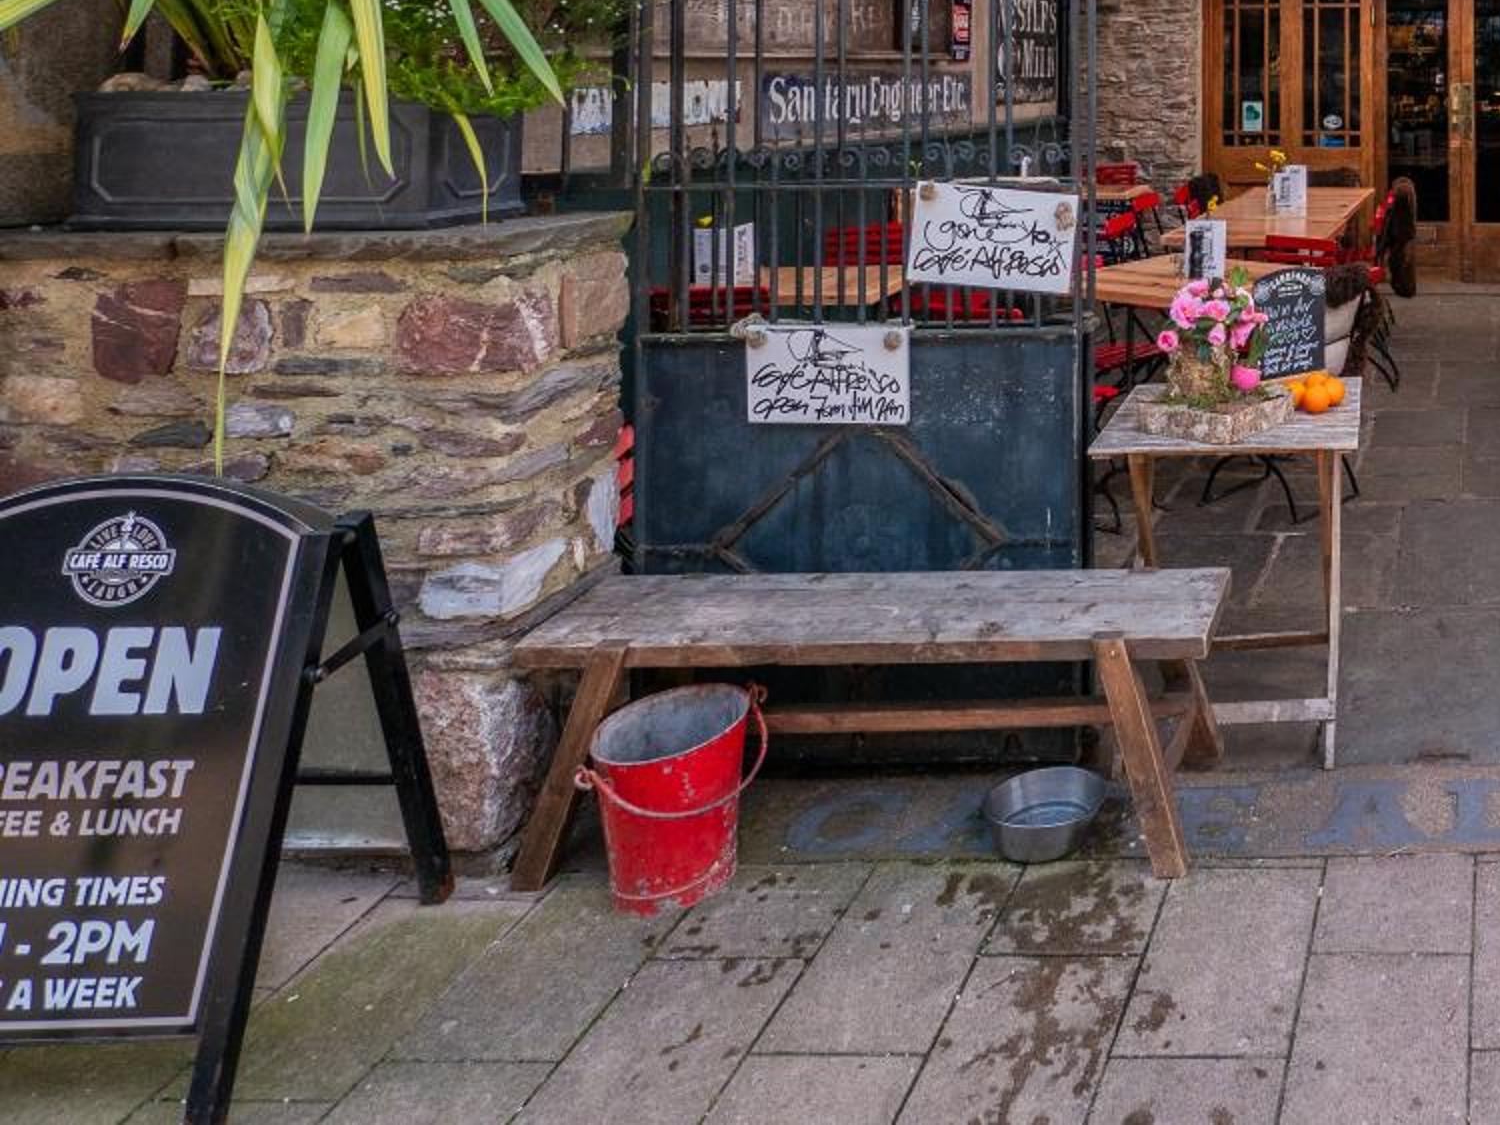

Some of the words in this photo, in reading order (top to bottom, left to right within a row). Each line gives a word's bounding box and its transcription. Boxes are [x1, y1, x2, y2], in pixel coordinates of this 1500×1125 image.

[769, 75, 867, 125] Santary
[69, 552, 102, 569] CAFÉ
[102, 554, 128, 569] ALF
[129, 554, 169, 569] RESCO
[0, 626, 223, 716] OPEN
[0, 759, 196, 800] EAKFAST
[49, 810, 72, 837] &
[78, 808, 183, 837] LUNCH
[75, 876, 166, 907] TIMES
[15, 944, 32, 956] -
[40, 918, 156, 965] 2PM
[6, 978, 33, 1011] A
[43, 976, 144, 1010] WEEK
